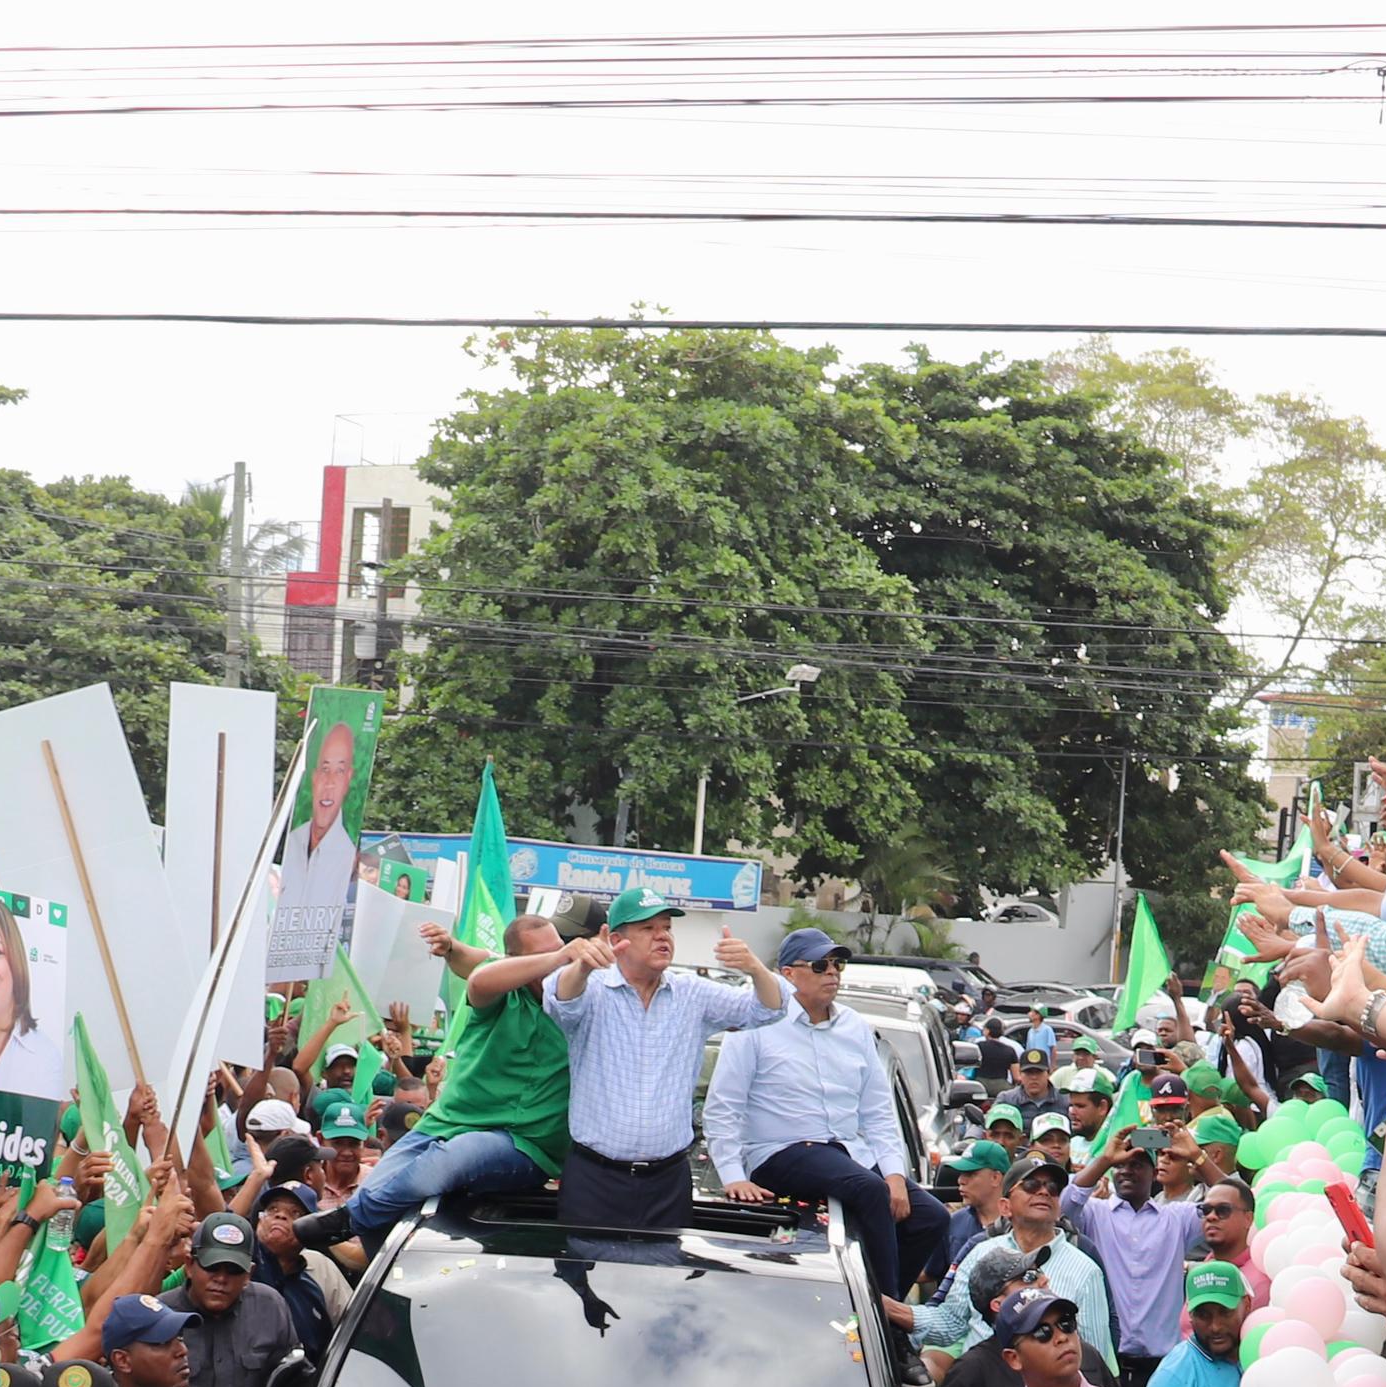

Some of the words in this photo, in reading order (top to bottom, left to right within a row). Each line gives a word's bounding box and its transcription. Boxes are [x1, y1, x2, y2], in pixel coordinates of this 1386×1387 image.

[558, 862, 621, 891] Ramón
[275, 905, 344, 932] HENRY
[20, 1292, 42, 1321] DEL
[30, 1273, 83, 1322] FUERZA
